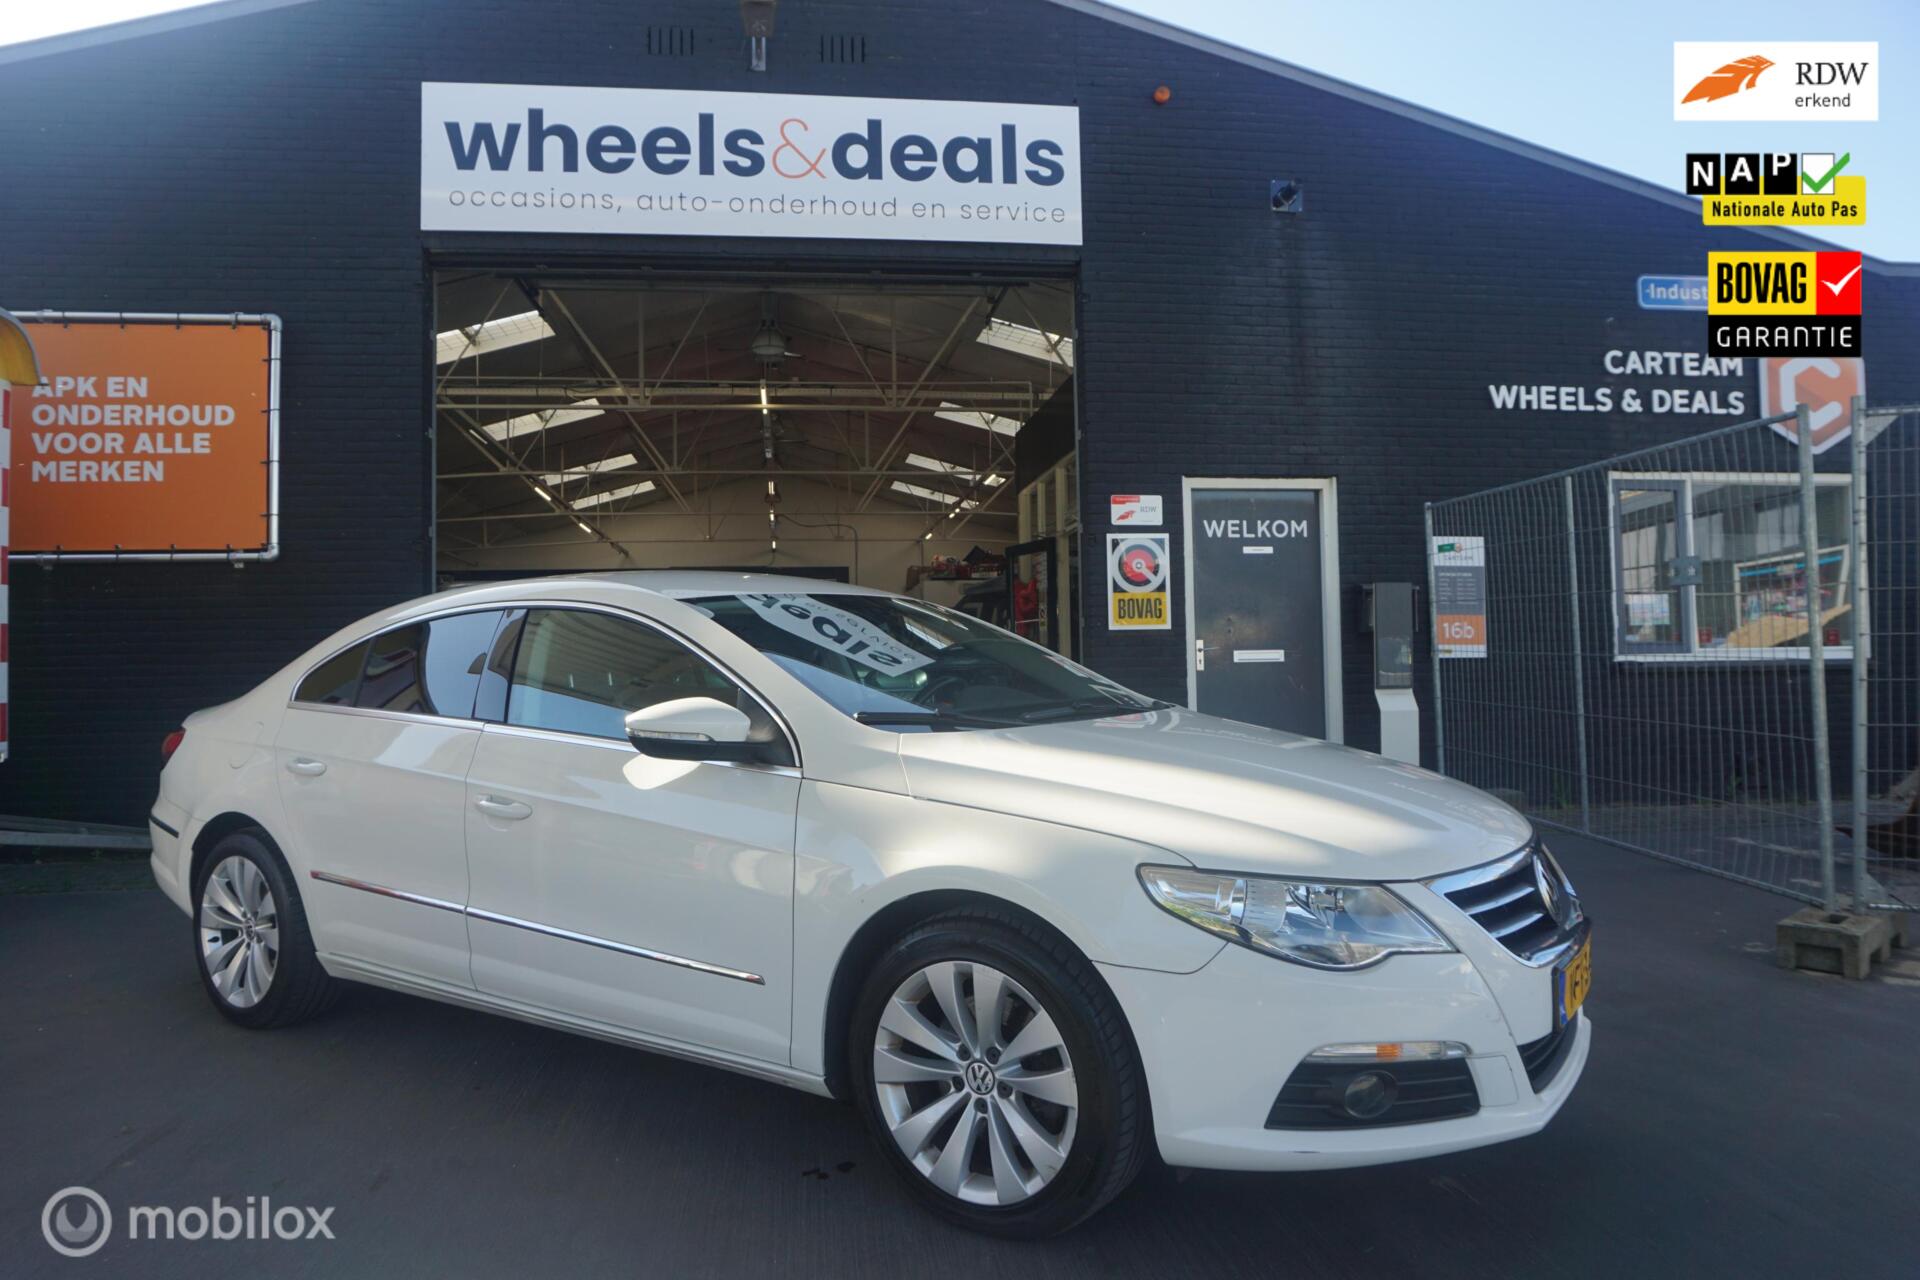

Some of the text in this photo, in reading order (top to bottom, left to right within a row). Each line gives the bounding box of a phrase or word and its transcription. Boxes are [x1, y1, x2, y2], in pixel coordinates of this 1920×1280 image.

[443, 107, 1065, 187] wheels&deals
[448, 187, 1066, 224] occasions, auto-onderhoud en service
[1604, 349, 1744, 377] CARTEAM
[31, 376, 148, 398] APK EN
[1488, 384, 1746, 416] WHEELS & DEALS
[31, 404, 235, 427] ONDERHOUD
[31, 432, 212, 454] VOOR ALLE
[31, 460, 164, 483] MERKEN
[1203, 519, 1309, 538] WELKOM
[1117, 598, 1163, 620] BOVAG
[1442, 622, 1475, 640] 16b
